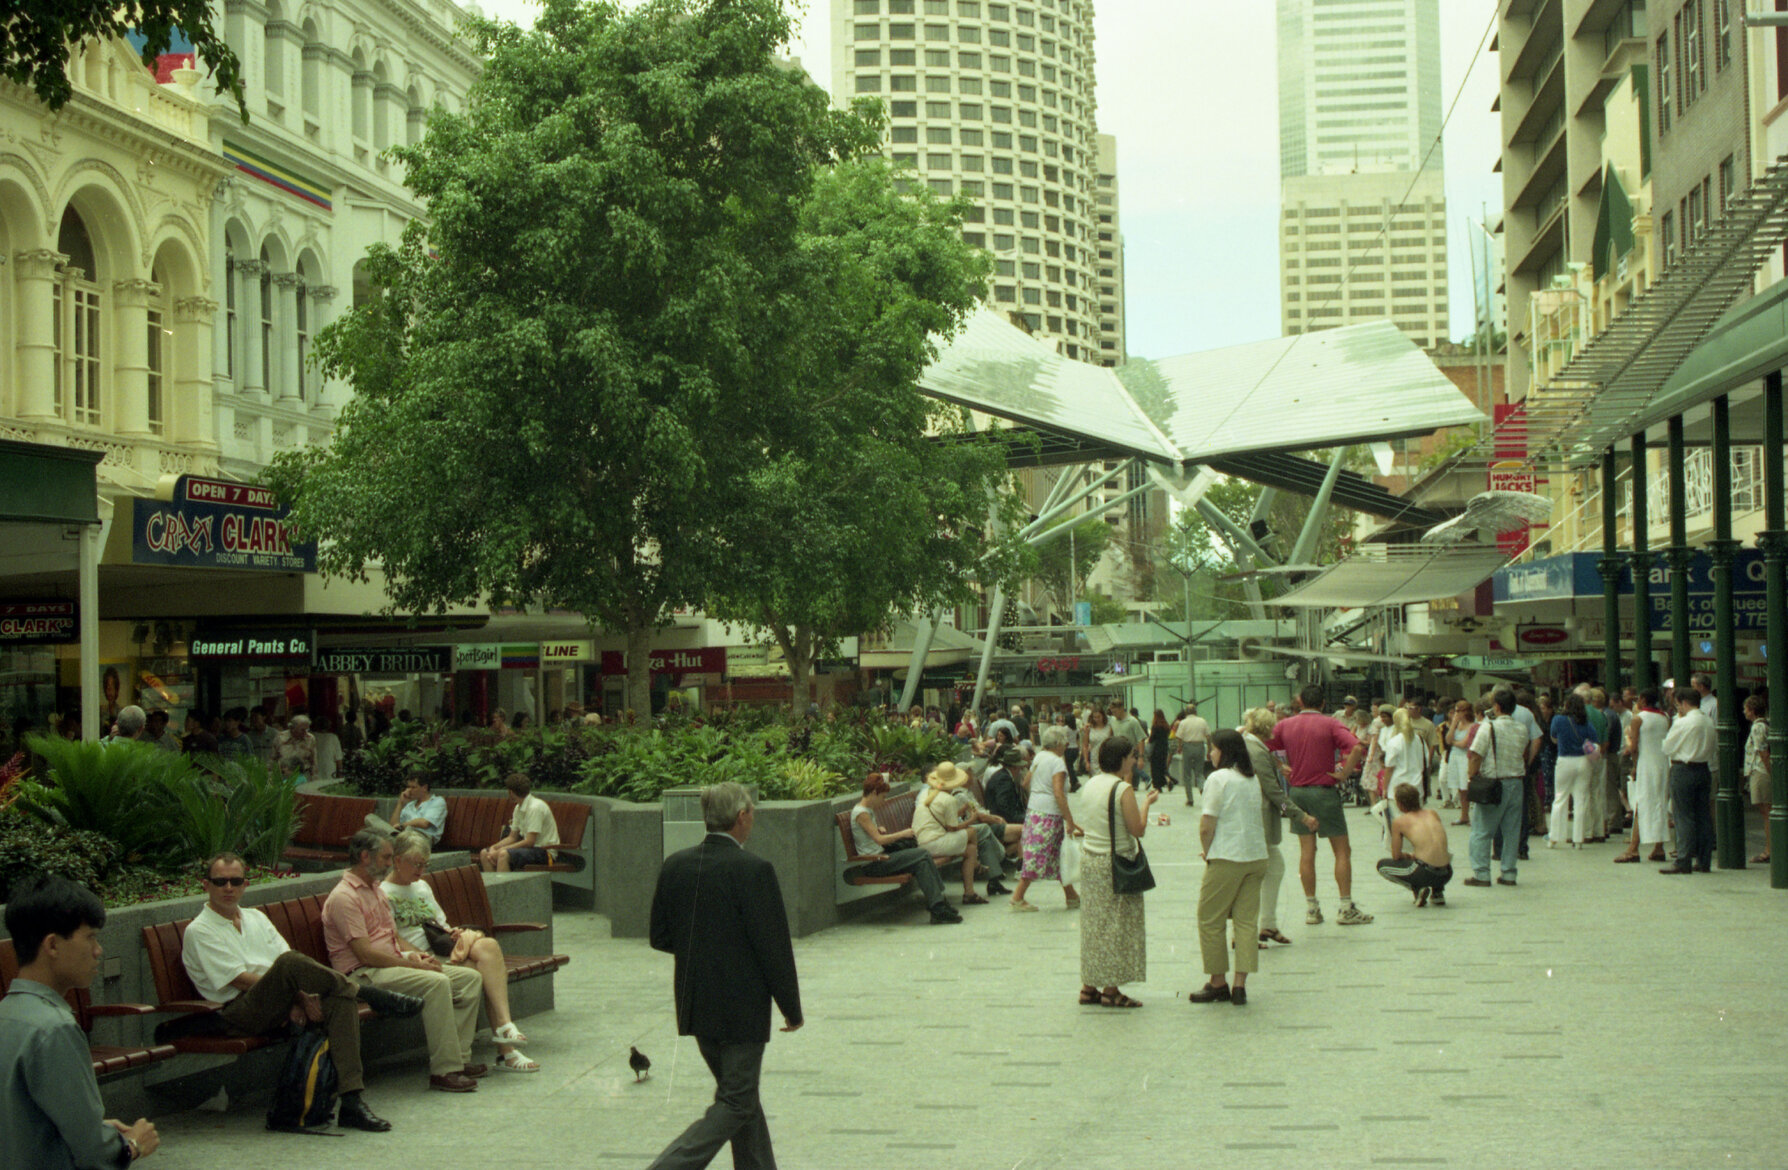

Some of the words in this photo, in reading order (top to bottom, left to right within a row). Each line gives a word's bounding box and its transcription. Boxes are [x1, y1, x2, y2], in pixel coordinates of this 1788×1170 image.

[192, 483, 226, 500] OPEN
[232, 489, 242, 501] 7
[147, 510, 215, 556] CRAZY
[215, 552, 249, 565] DISCOUNT
[252, 556, 278, 566] VARIETY
[281, 557, 305, 568] STORES
[26, 605, 66, 613] DAYS
[192, 640, 243, 655] General
[248, 639, 285, 654] Pants
[289, 638, 310, 653] Co.
[542, 645, 580, 657] LINE
[317, 654, 375, 673] ABBEY
[668, 652, 703, 668] Hut
